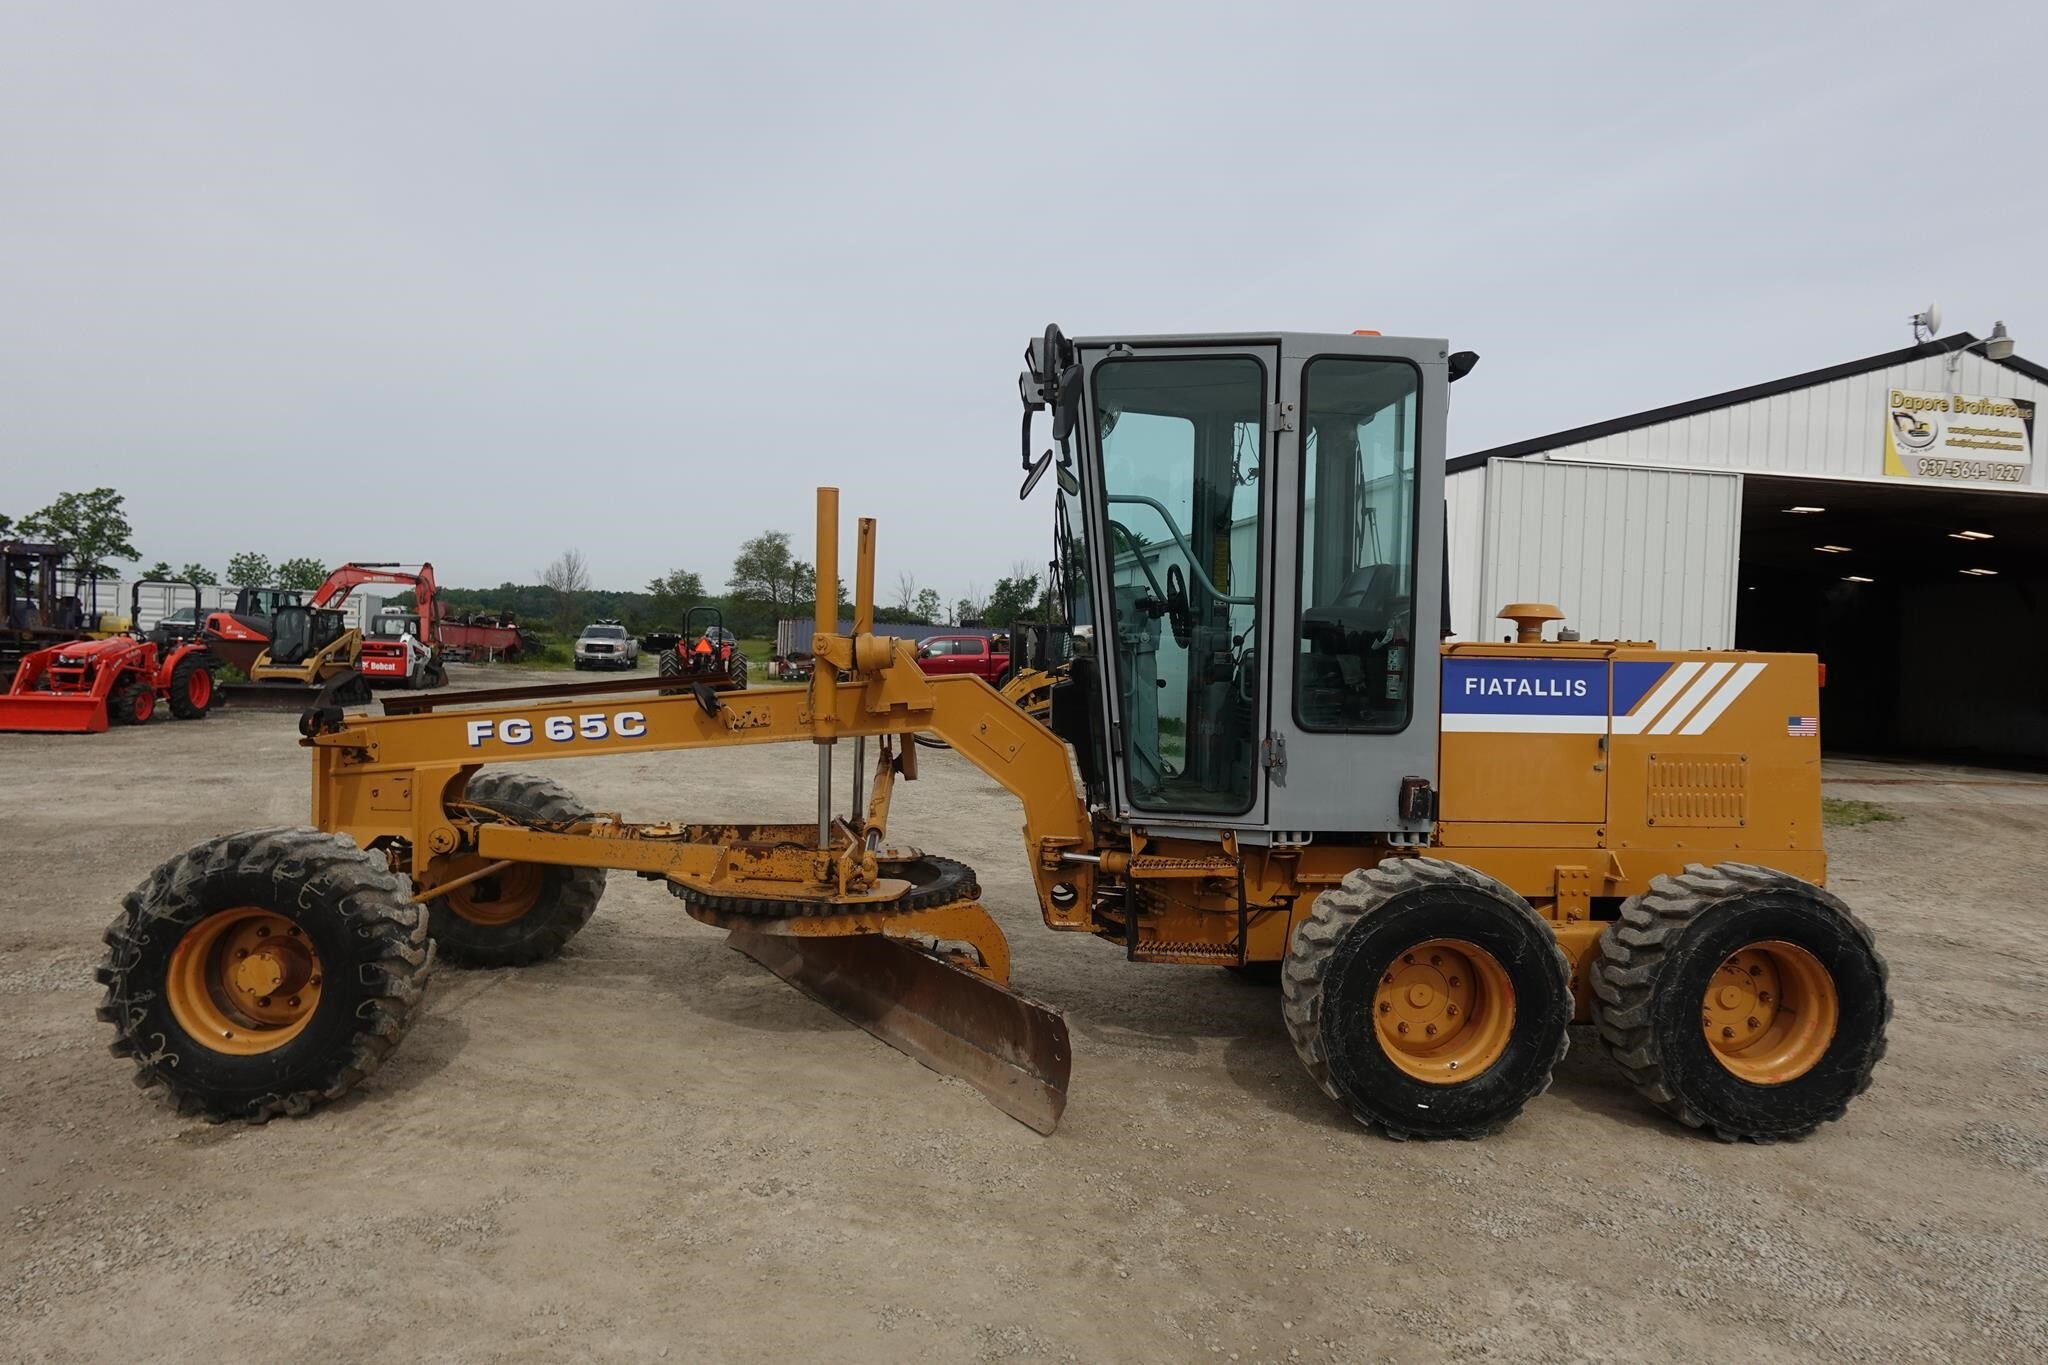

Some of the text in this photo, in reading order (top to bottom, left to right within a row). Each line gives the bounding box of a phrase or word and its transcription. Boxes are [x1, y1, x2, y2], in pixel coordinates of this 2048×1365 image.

[1891, 391, 1949, 413] Dapore
[1953, 396, 2018, 416] Brothers
[1919, 458, 2024, 481] 937-564-1227
[370, 661, 396, 671] Bobcat
[1465, 678, 1587, 696] FIATALLIS
[466, 711, 647, 747] FG 65C
